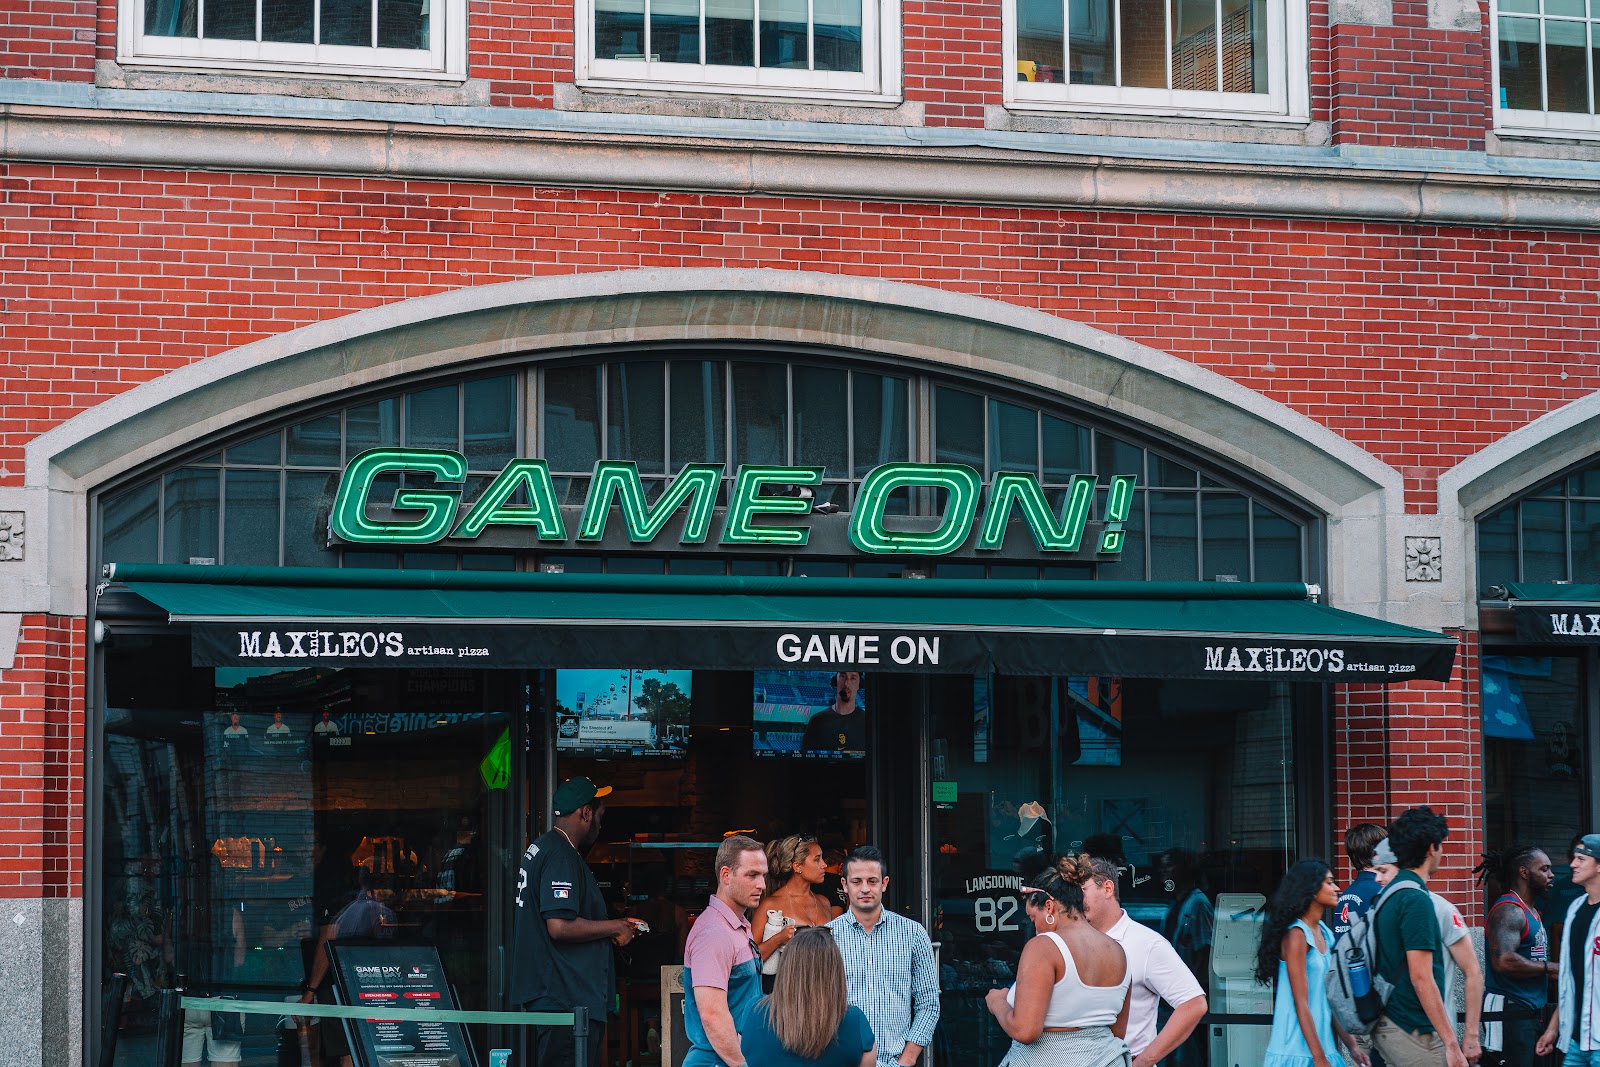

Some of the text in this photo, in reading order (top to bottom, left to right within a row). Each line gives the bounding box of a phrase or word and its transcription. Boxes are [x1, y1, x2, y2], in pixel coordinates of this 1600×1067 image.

[332, 447, 1137, 555] GAME ON!
[1550, 613, 1600, 636] MAX
[238, 631, 308, 658] MAX
[319, 631, 404, 658] LEO'S
[407, 645, 454, 656] artisan
[458, 646, 490, 658] pizza
[776, 633, 940, 665] GAME ON
[1204, 646, 1265, 672] MAX
[1273, 648, 1345, 673] LEO'S
[1346, 661, 1386, 672] artisan
[1387, 663, 1416, 674] pizza
[965, 875, 1025, 894] LANSDOWNE
[974, 895, 1020, 933] 82
